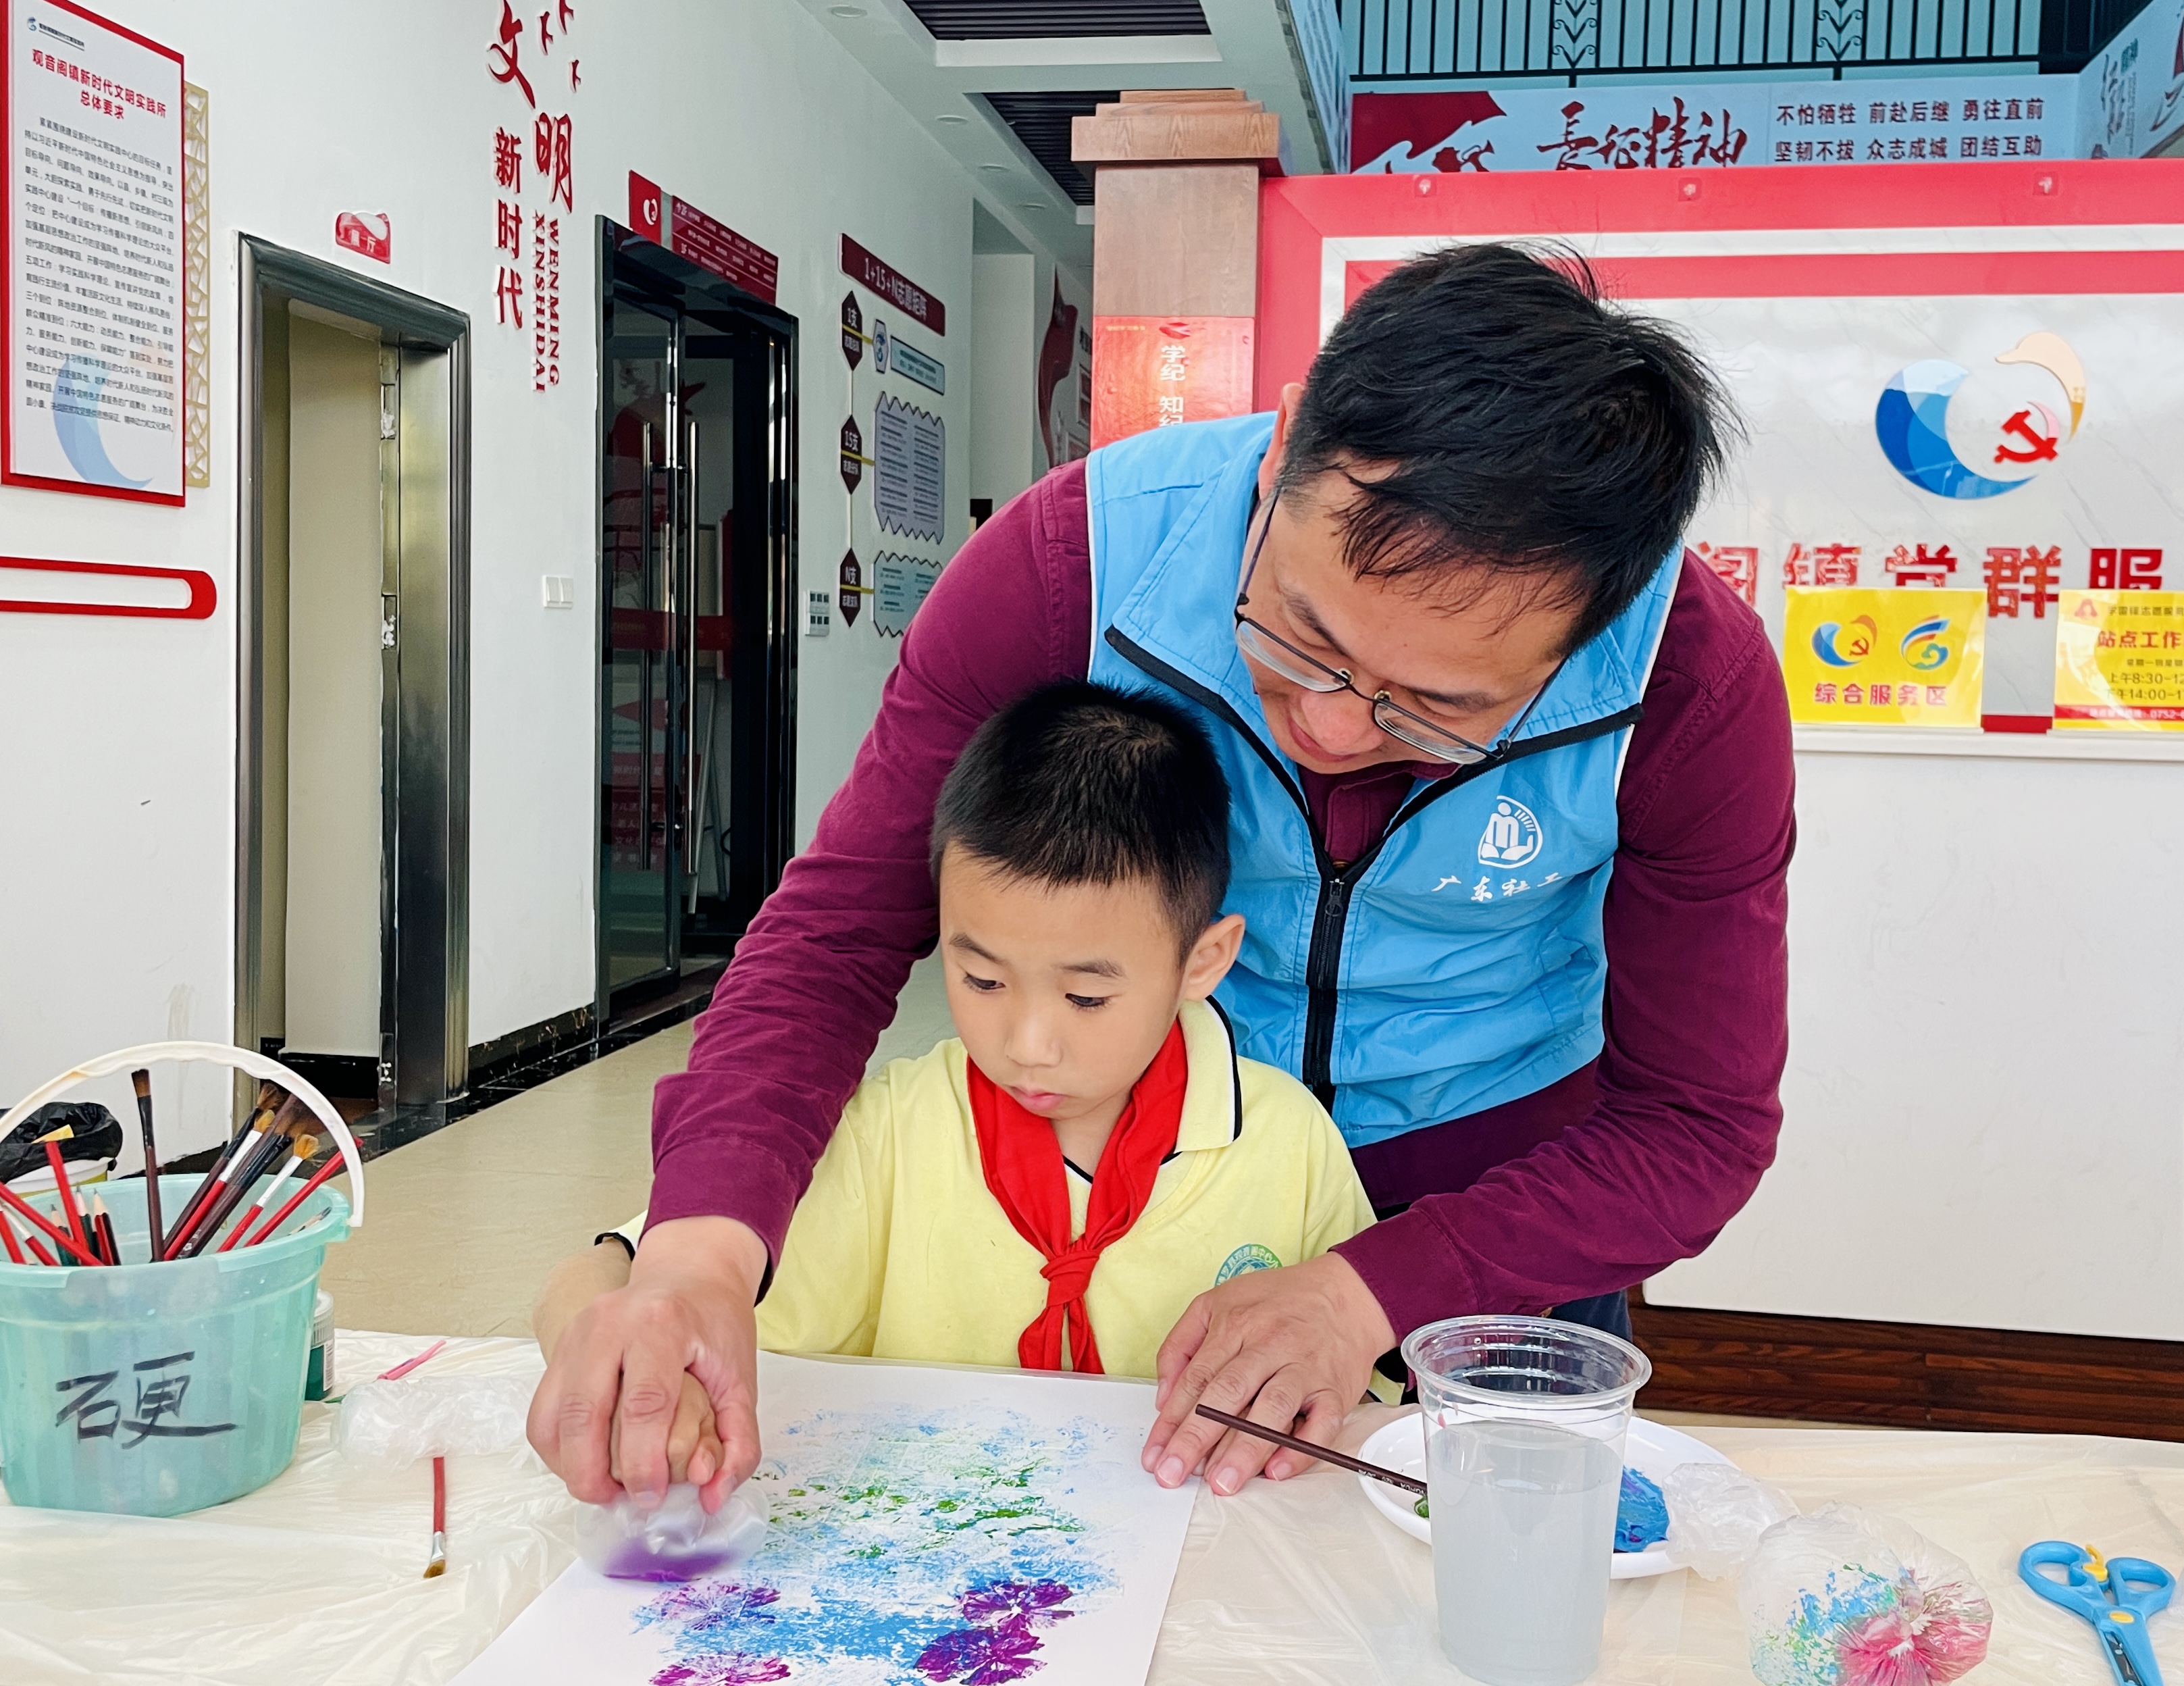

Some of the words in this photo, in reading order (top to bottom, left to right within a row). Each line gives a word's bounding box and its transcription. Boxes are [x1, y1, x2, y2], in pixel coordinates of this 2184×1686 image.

[80, 89, 125, 120] 总体要求
[1776, 102, 1857, 126] 不怕牺牲
[1868, 101, 1950, 124] 前赴后继
[1962, 97, 2045, 122] 勇往直前
[1775, 139, 1855, 162] 坚韧不拔
[1866, 136, 1948, 161] 众志成城
[1960, 134, 2043, 158] 团结互助
[494, 126, 523, 330] 新时代
[534, 210, 546, 393] XINSHIDAI
[548, 217, 560, 386] WENMING
[1160, 344, 1186, 381] 学纪
[1814, 682, 1947, 706] 综合服务区
[1430, 871, 1563, 902] 广东社工
[55, 1350, 238, 1450] 硬
